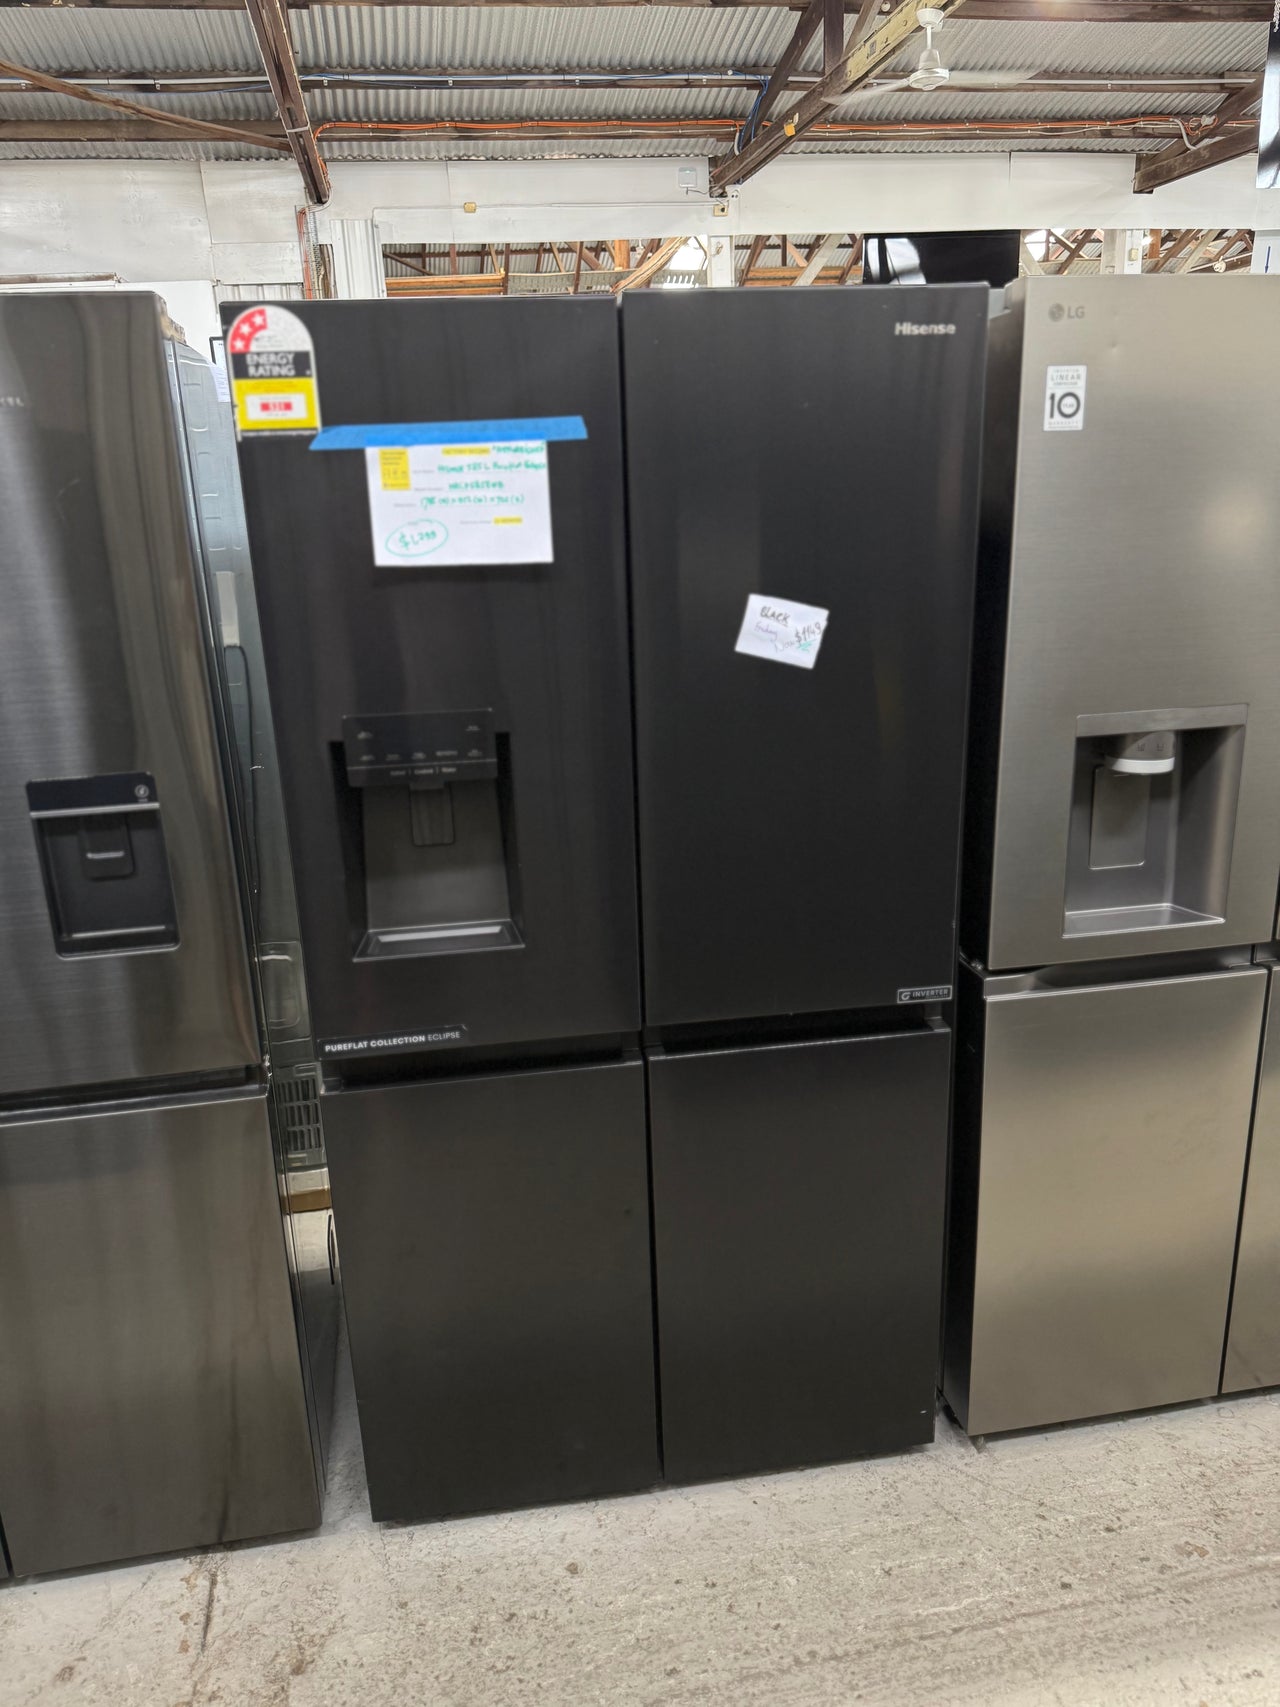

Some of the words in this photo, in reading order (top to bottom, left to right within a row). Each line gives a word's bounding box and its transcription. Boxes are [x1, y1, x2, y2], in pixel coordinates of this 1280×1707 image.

[1067, 306, 1085, 319] LG
[894, 322, 956, 336] Hisense
[246, 353, 296, 365] ENERGY
[248, 365, 296, 377] RATING
[1049, 391, 1081, 419] 10
[760, 606, 790, 625] BLACK
[913, 989, 948, 997] INVERTER
[325, 1041, 369, 1052] PUREFLAT
[370, 1035, 426, 1048] COLLECTION
[427, 1031, 461, 1042] ECLIPSE
